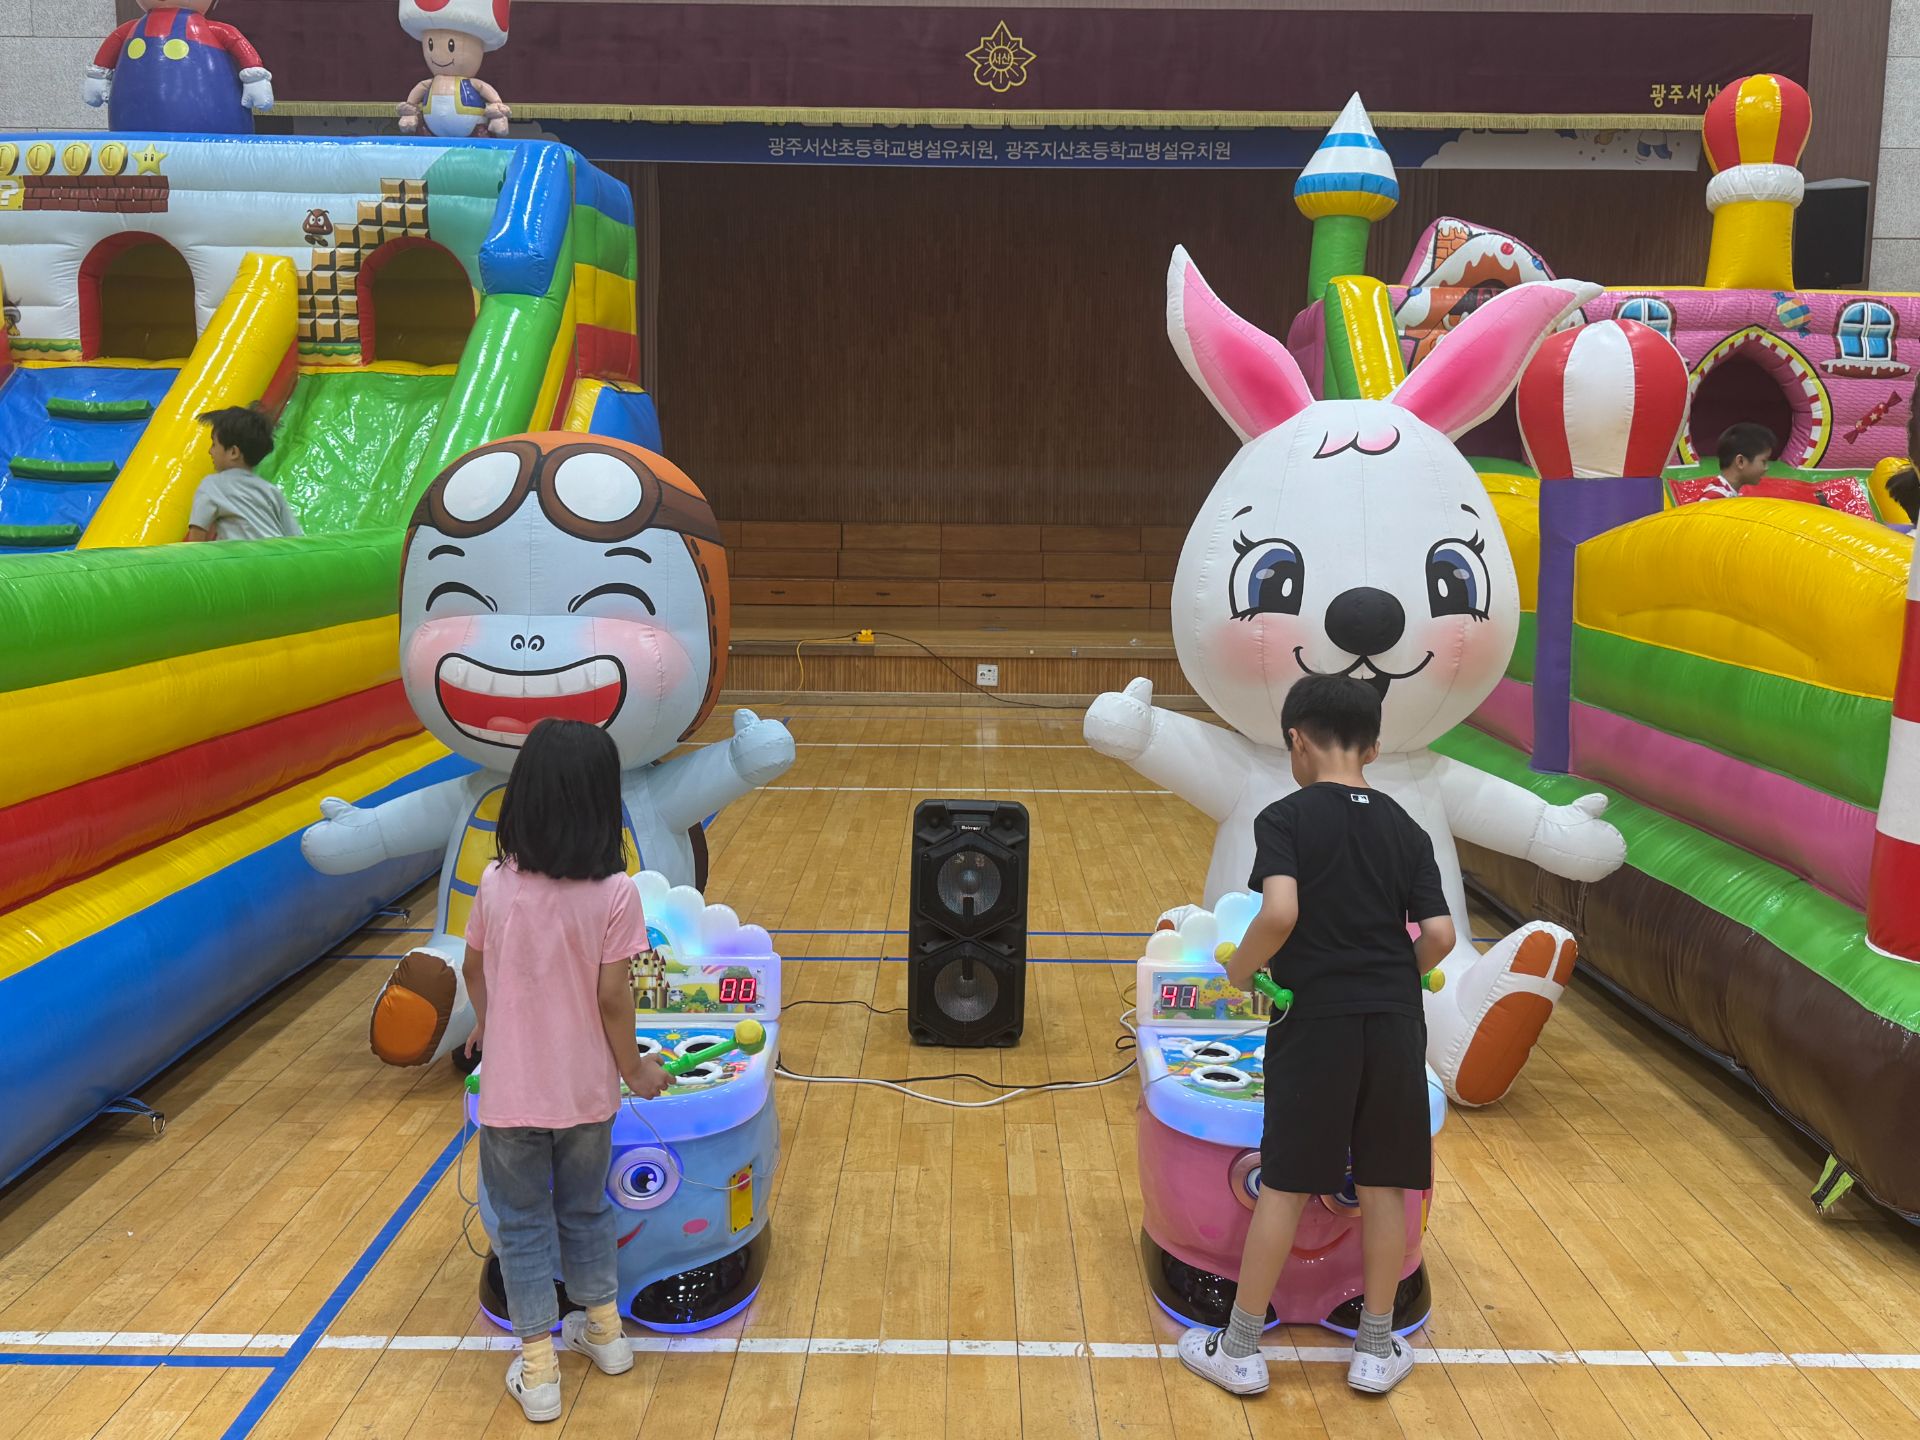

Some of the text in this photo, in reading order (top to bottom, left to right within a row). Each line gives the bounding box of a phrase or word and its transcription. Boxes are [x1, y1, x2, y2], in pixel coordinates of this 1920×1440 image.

[993, 52, 1010, 65] 서산
[768, 137, 1231, 161] 광주서산초등학교병설유치원, 광주지산초등학교병설유치원
[720, 978, 756, 1002] 00
[1162, 985, 1197, 1009] 41
